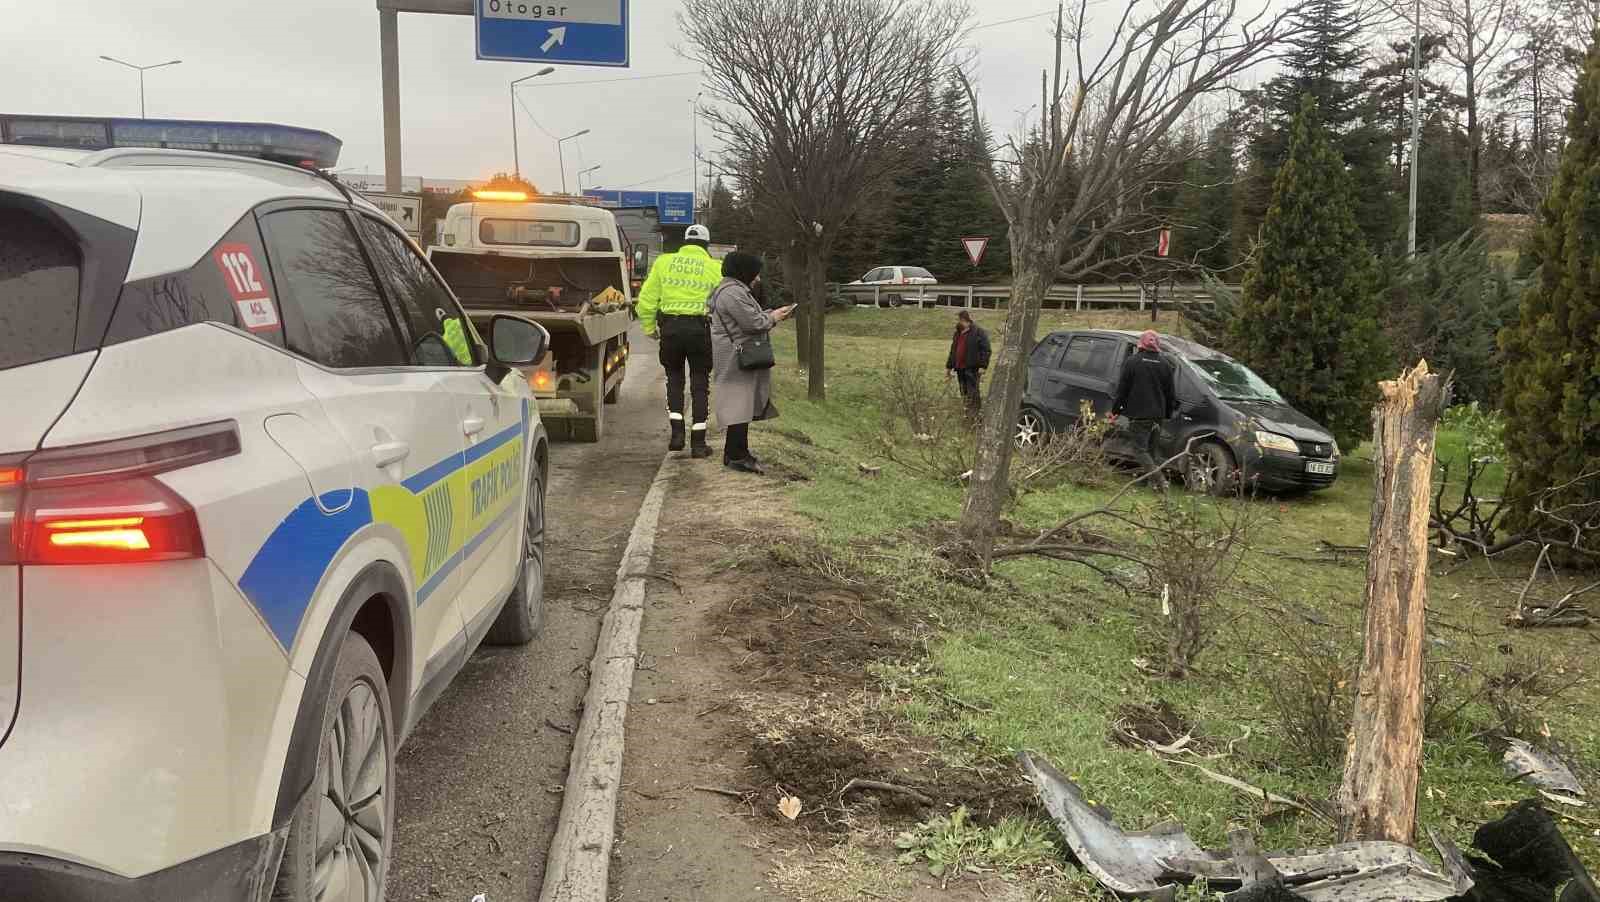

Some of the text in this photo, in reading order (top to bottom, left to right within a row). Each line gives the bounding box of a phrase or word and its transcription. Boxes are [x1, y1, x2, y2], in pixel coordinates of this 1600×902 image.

[489, 0, 568, 18] Otogar
[222, 252, 263, 293] 112
[471, 459, 499, 520] TRAFİK
